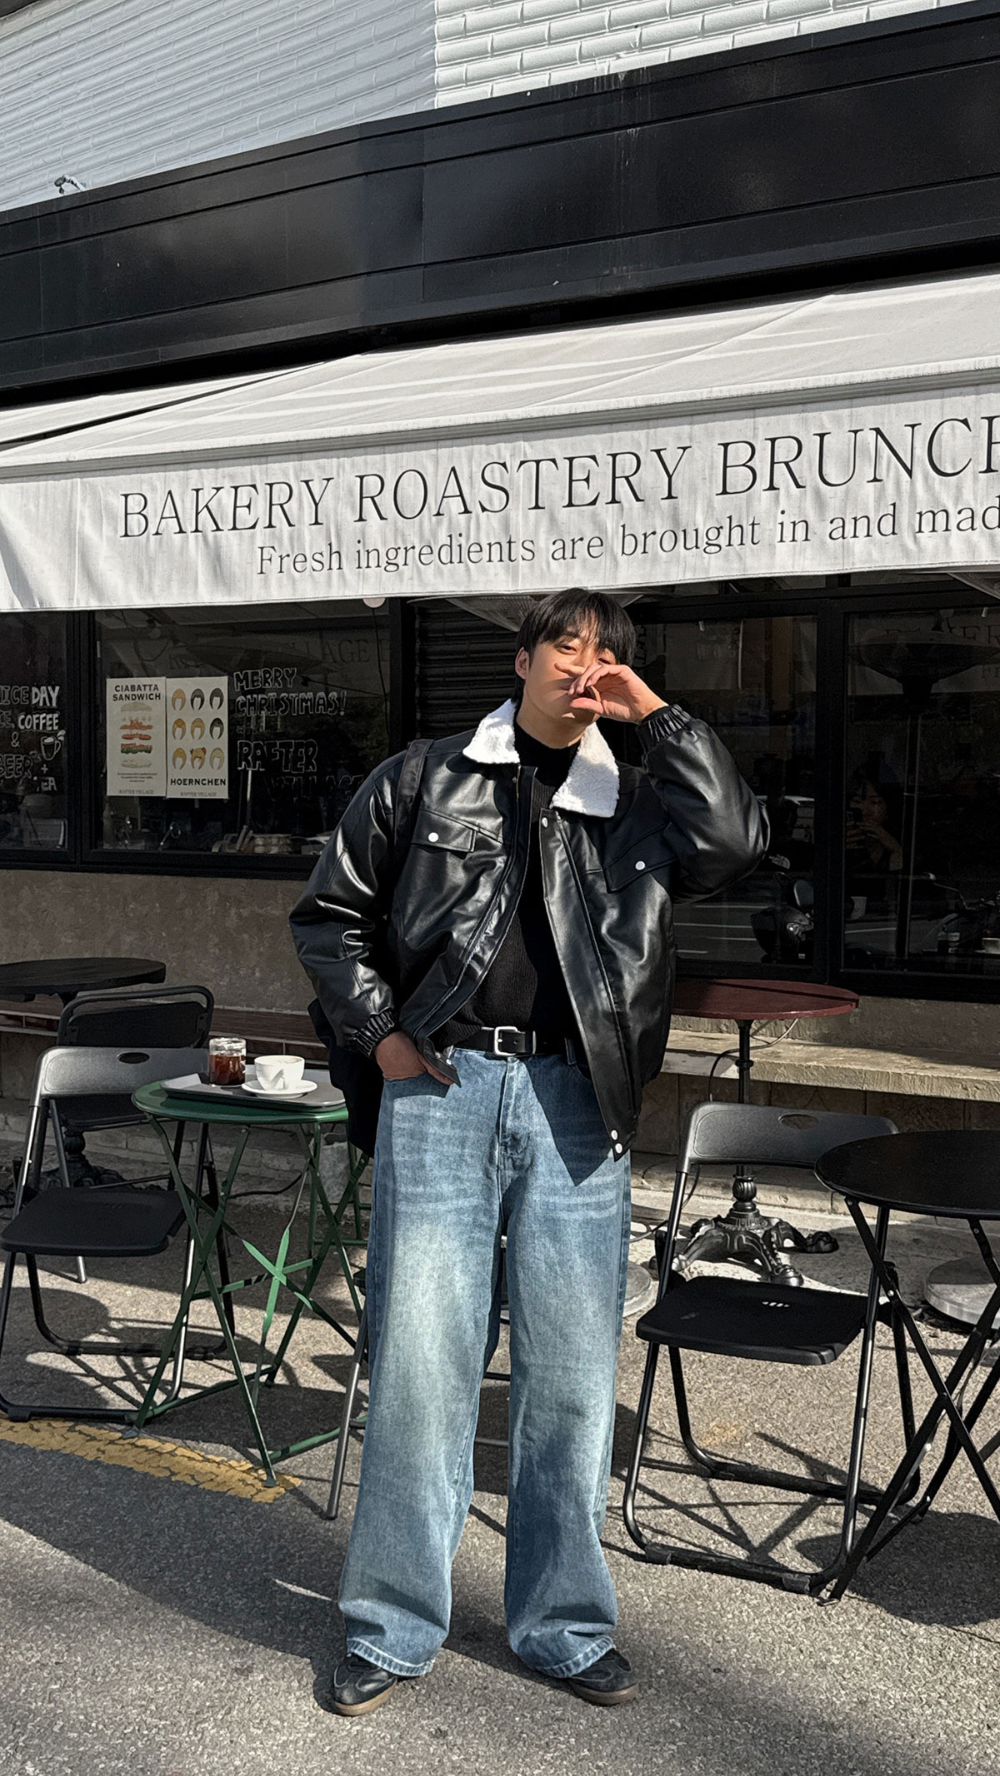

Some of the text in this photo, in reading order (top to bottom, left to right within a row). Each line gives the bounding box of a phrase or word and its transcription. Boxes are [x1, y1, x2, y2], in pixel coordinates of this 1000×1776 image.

[119, 477, 335, 539] BAKERY
[353, 445, 693, 523] ROASTERY
[257, 536, 344, 575] Fresh
[355, 533, 536, 574] ingredients
[551, 534, 605, 562] are
[620, 514, 761, 556] brought
[777, 509, 811, 544] in
[828, 501, 899, 541] and
[114, 684, 160, 693] CIABATTA
[233, 667, 298, 692] MERRY
[31, 685, 60, 708] DAY
[113, 693, 161, 702] SANDWICH
[234, 690, 348, 717] CHRISTMAS!
[17, 711, 60, 732] COFFEE
[170, 778, 227, 787] HOERNCHEN
